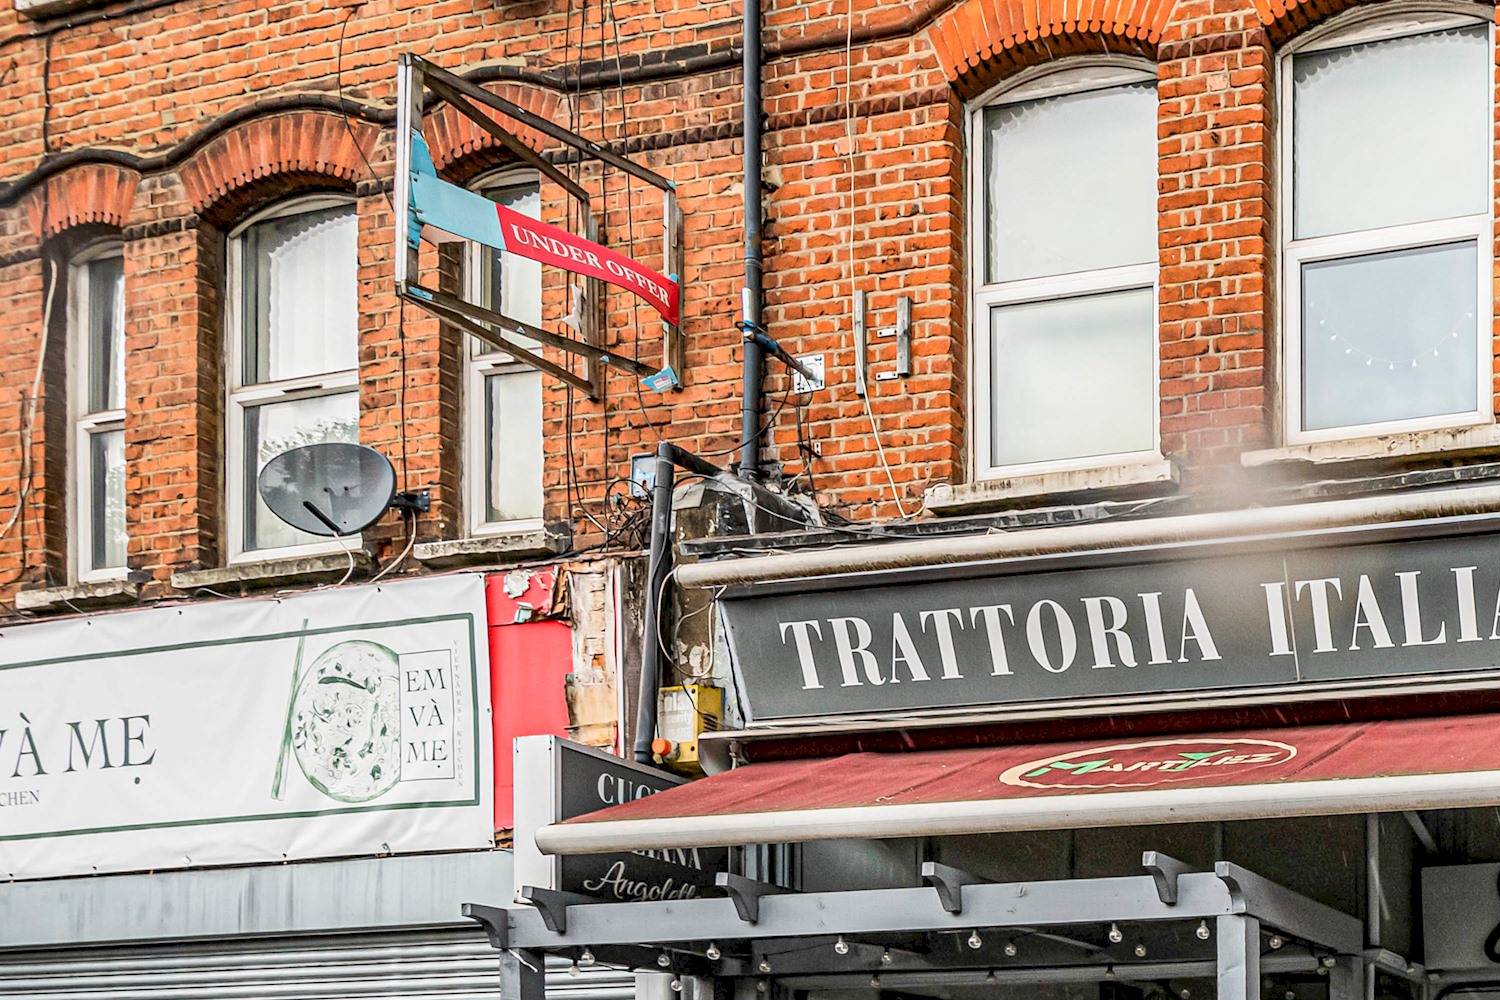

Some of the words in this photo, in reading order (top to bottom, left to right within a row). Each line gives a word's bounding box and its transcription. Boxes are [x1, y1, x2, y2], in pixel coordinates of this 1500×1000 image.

[510, 223, 604, 271] UNDER
[605, 259, 671, 308] OFFER
[780, 588, 1222, 690] TRATTORIA
[405, 668, 447, 693] EM
[408, 698, 445, 728] VÀ
[0, 711, 49, 778] À
[62, 714, 157, 785] MẸ
[406, 739, 448, 769] MẸ
[0, 789, 40, 807] CHEN
[583, 861, 697, 901] Angolett
